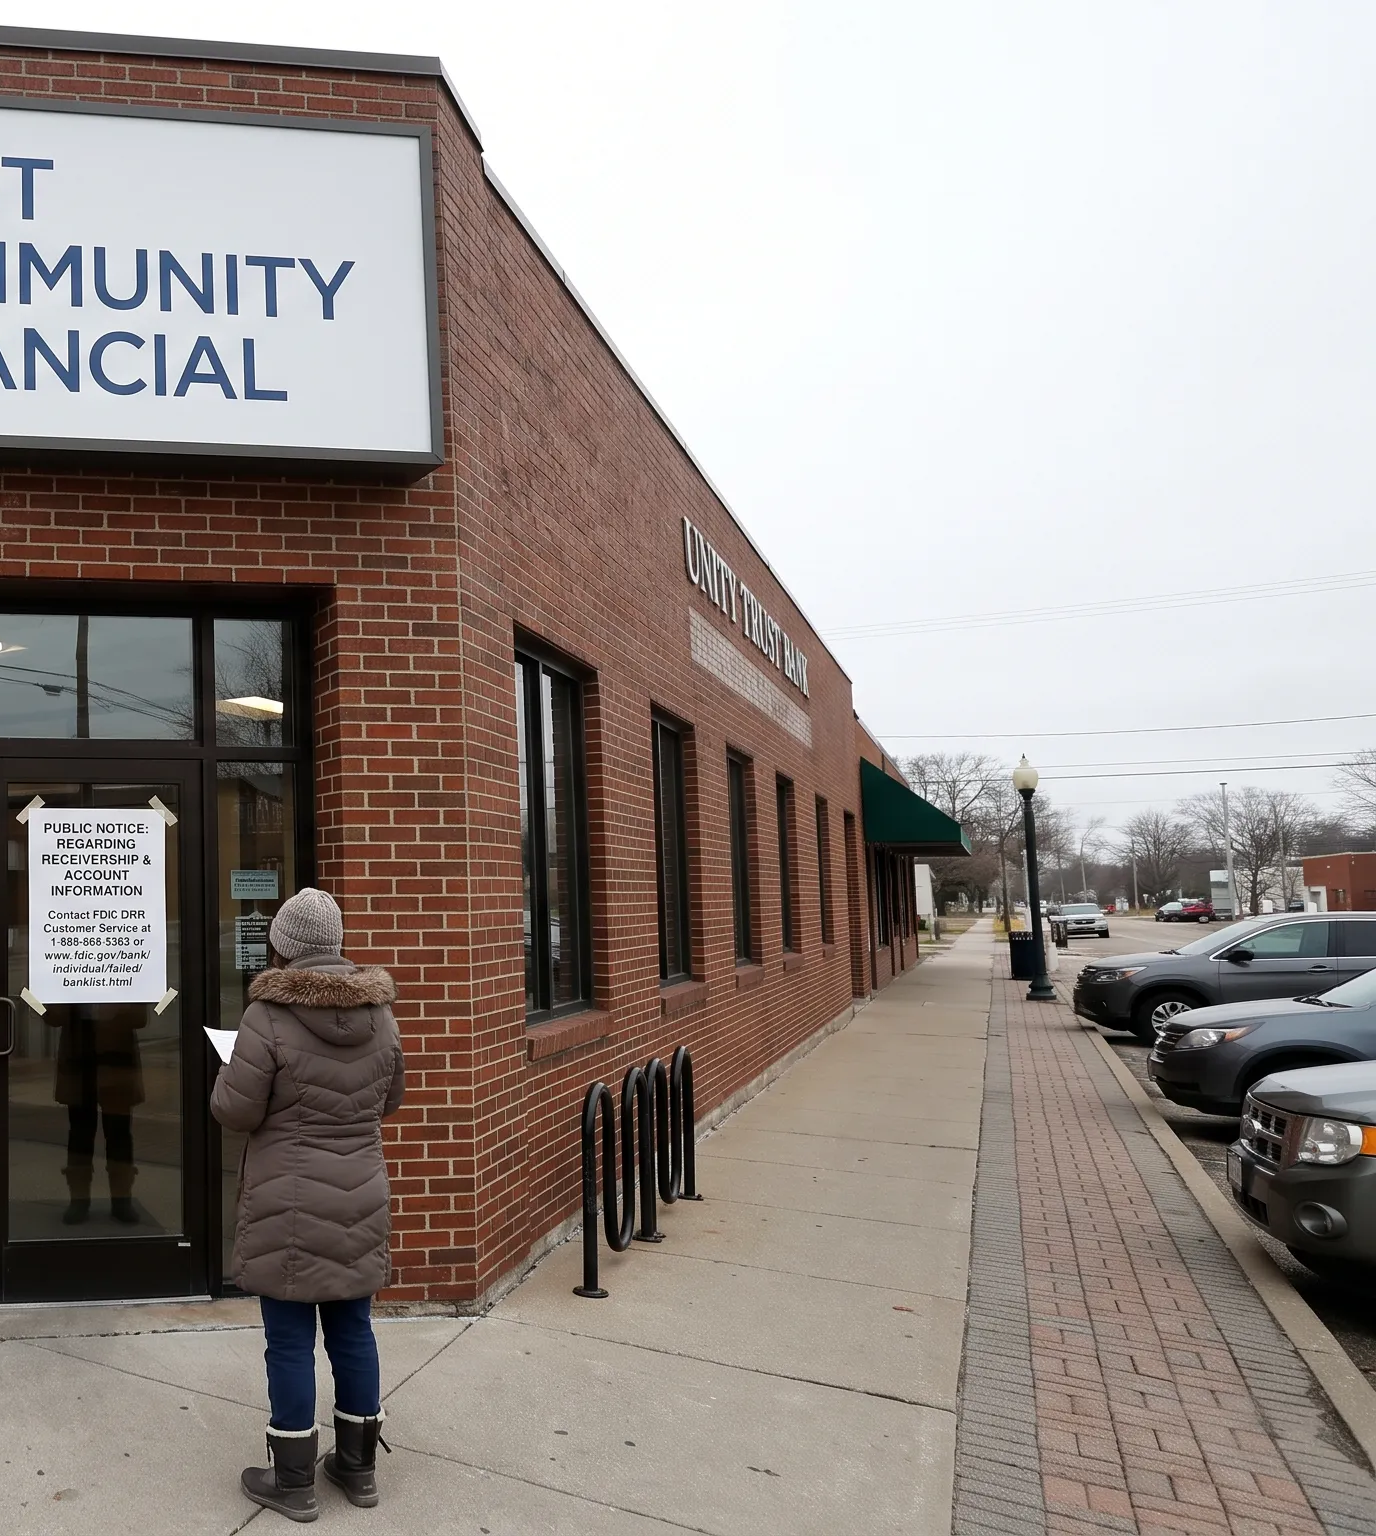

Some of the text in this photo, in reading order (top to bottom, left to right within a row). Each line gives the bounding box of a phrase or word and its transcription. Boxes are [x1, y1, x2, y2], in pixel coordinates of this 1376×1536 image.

[682, 515, 810, 699] UNITY TRUST BANK
[43, 823, 149, 834] PUBLIC NOTICE:
[56, 838, 136, 850] REGARDING
[41, 854, 152, 866] RECEIVERSHIP &
[63, 869, 130, 881] ACCOUNT
[51, 885, 143, 897] INFORMATION
[47, 909, 146, 920] Contact FDIC DRR
[43, 923, 151, 934] Customer Service at
[133, 938, 145, 947] or
[52, 963, 143, 974] individual/failed/
[62, 977, 133, 987] banklist.html
